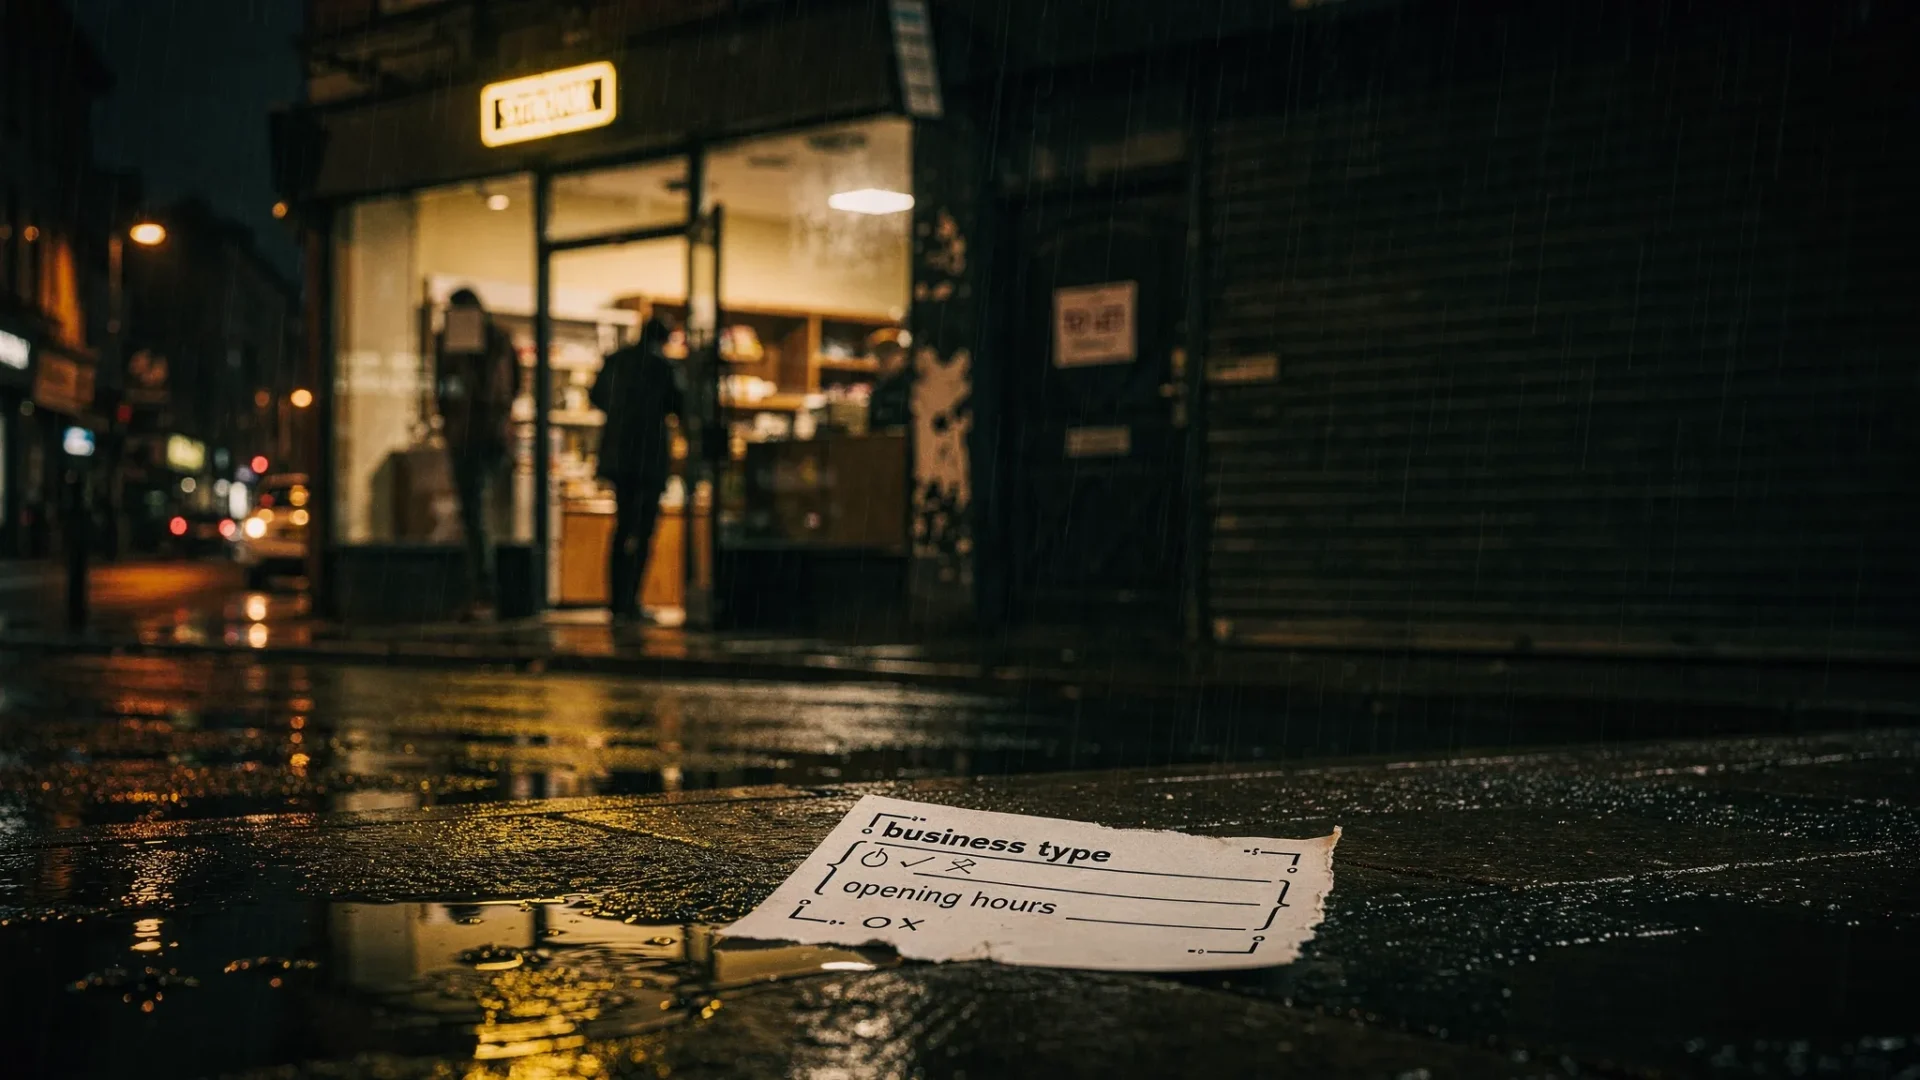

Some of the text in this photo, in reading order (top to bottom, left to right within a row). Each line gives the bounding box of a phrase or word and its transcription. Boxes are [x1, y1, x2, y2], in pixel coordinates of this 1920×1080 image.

[882, 821, 1111, 864] business type
[843, 881, 1058, 914] opening hours
